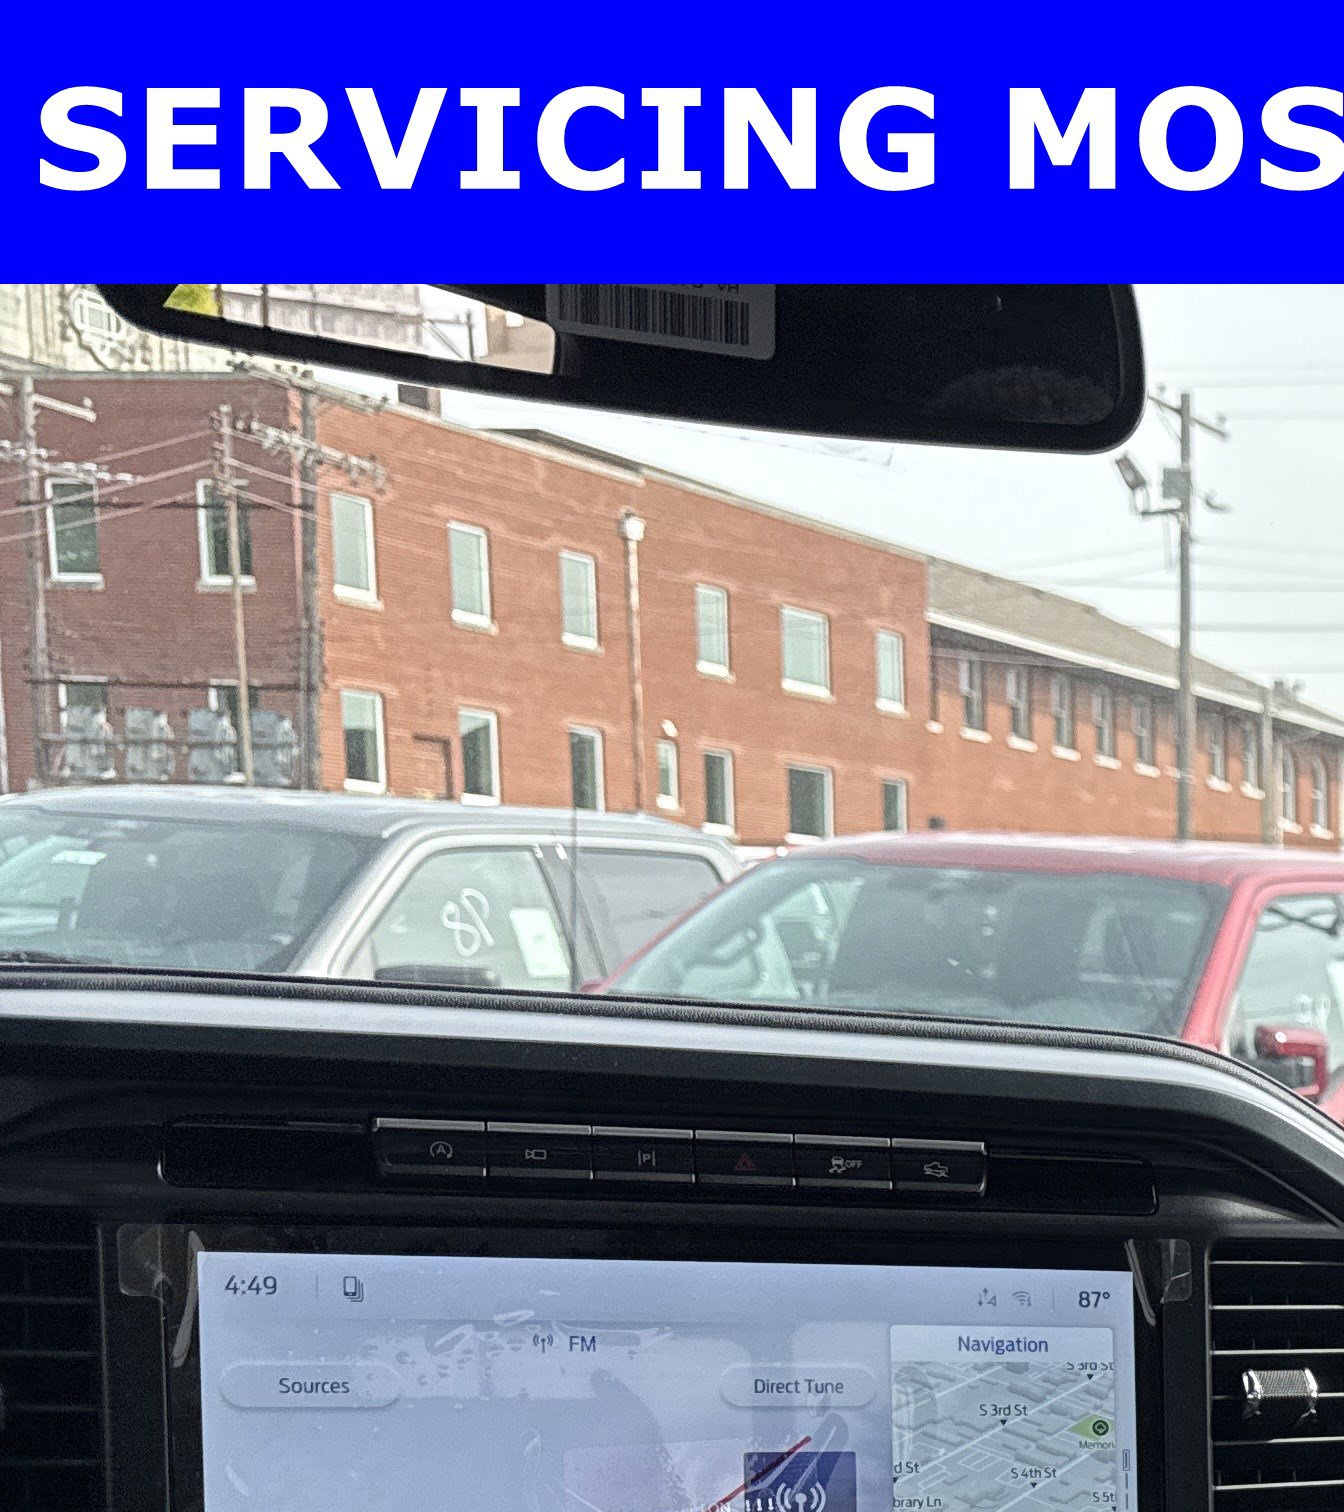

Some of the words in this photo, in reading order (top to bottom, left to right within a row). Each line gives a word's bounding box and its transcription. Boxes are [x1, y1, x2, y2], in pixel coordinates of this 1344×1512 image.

[844, 1159, 863, 1169] OFF
[225, 1275, 278, 1296] 4:49
[1077, 1291, 1110, 1309] 87°
[568, 1336, 598, 1352] FM
[957, 1335, 1049, 1355] Navigation
[279, 1377, 350, 1396] Sources
[754, 1378, 799, 1396] Direct
[801, 1378, 844, 1396] Tune
[979, 1404, 988, 1416] S
[990, 1404, 1012, 1416] 3rd
[1013, 1404, 1028, 1416] St
[905, 1462, 920, 1473] St
[1010, 1467, 1019, 1479] S
[1021, 1467, 1042, 1479] 4th
[1044, 1467, 1057, 1478] St
[926, 1496, 942, 1507] Ln
[1092, 1491, 1101, 1502] S
